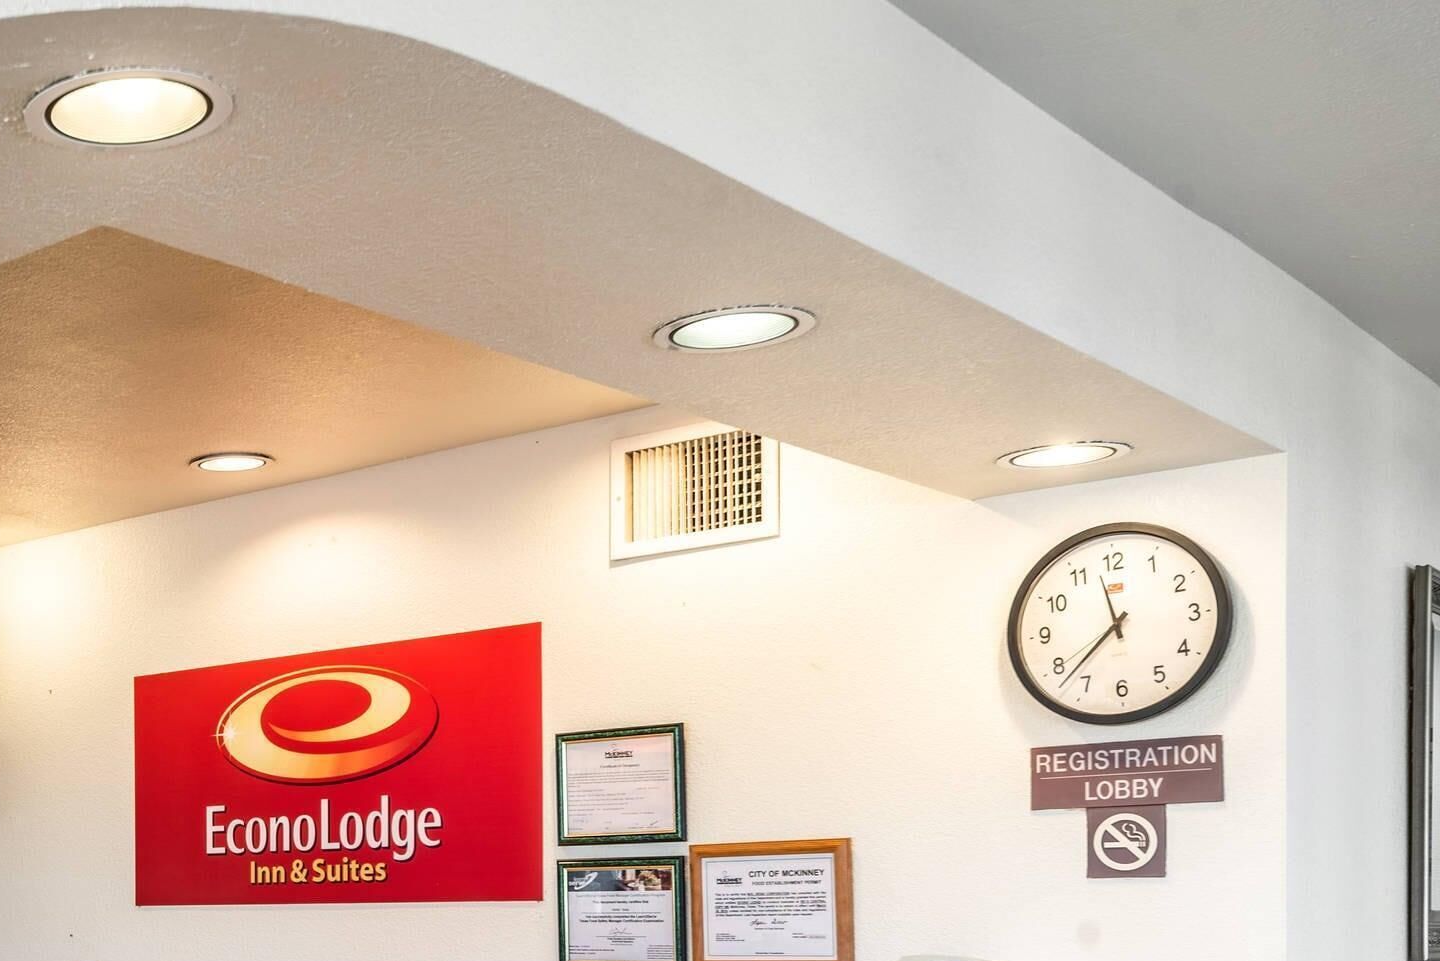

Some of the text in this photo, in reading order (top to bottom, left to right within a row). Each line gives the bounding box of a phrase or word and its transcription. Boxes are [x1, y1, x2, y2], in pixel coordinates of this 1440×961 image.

[1102, 552, 1124, 572] 12
[1147, 555, 1156, 573] 1
[1070, 568, 1087, 586] 11
[1173, 574, 1186, 593] 2
[1047, 594, 1067, 613] 10
[1188, 603, 1201, 621] 3
[1039, 626, 1051, 644] 9
[1177, 638, 1191, 657] 4
[1053, 657, 1065, 675] 8
[1153, 665, 1166, 683] 5
[1080, 675, 1091, 693] 7
[1116, 680, 1129, 698] 6
[1036, 743, 1217, 773] REGISTRATION
[1085, 778, 1164, 800] LOBBY
[250, 857, 387, 884] Inn & Suites
[748, 868, 825, 878] CITY OF MCKINNEY
